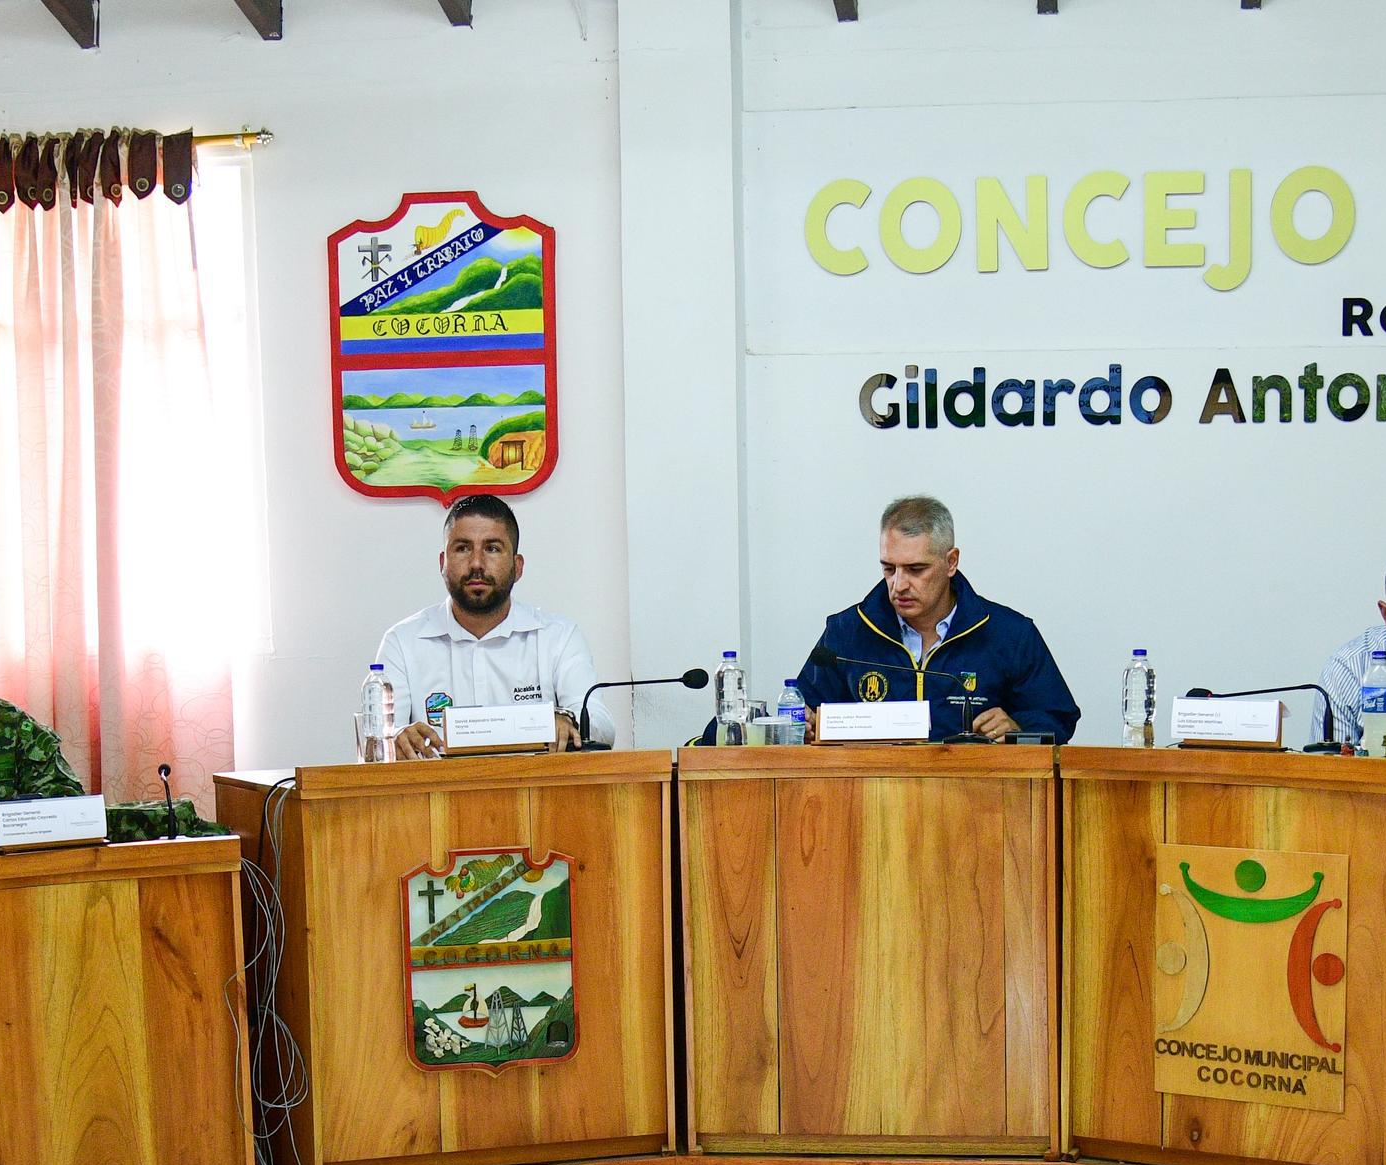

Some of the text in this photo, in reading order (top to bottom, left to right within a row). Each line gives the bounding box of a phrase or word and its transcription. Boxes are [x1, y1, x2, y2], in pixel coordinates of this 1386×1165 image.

[804, 166, 1356, 291] CONCEJO
[360, 280, 398, 312] PAZ
[397, 271, 413, 288] Y
[859, 364, 1173, 429] Gildardo
[514, 684, 535, 693] Alcaldía
[1154, 1038, 1343, 1076] CONCEJO MUNICIPAL
[1197, 1065, 1308, 1096] COCORNÁ
